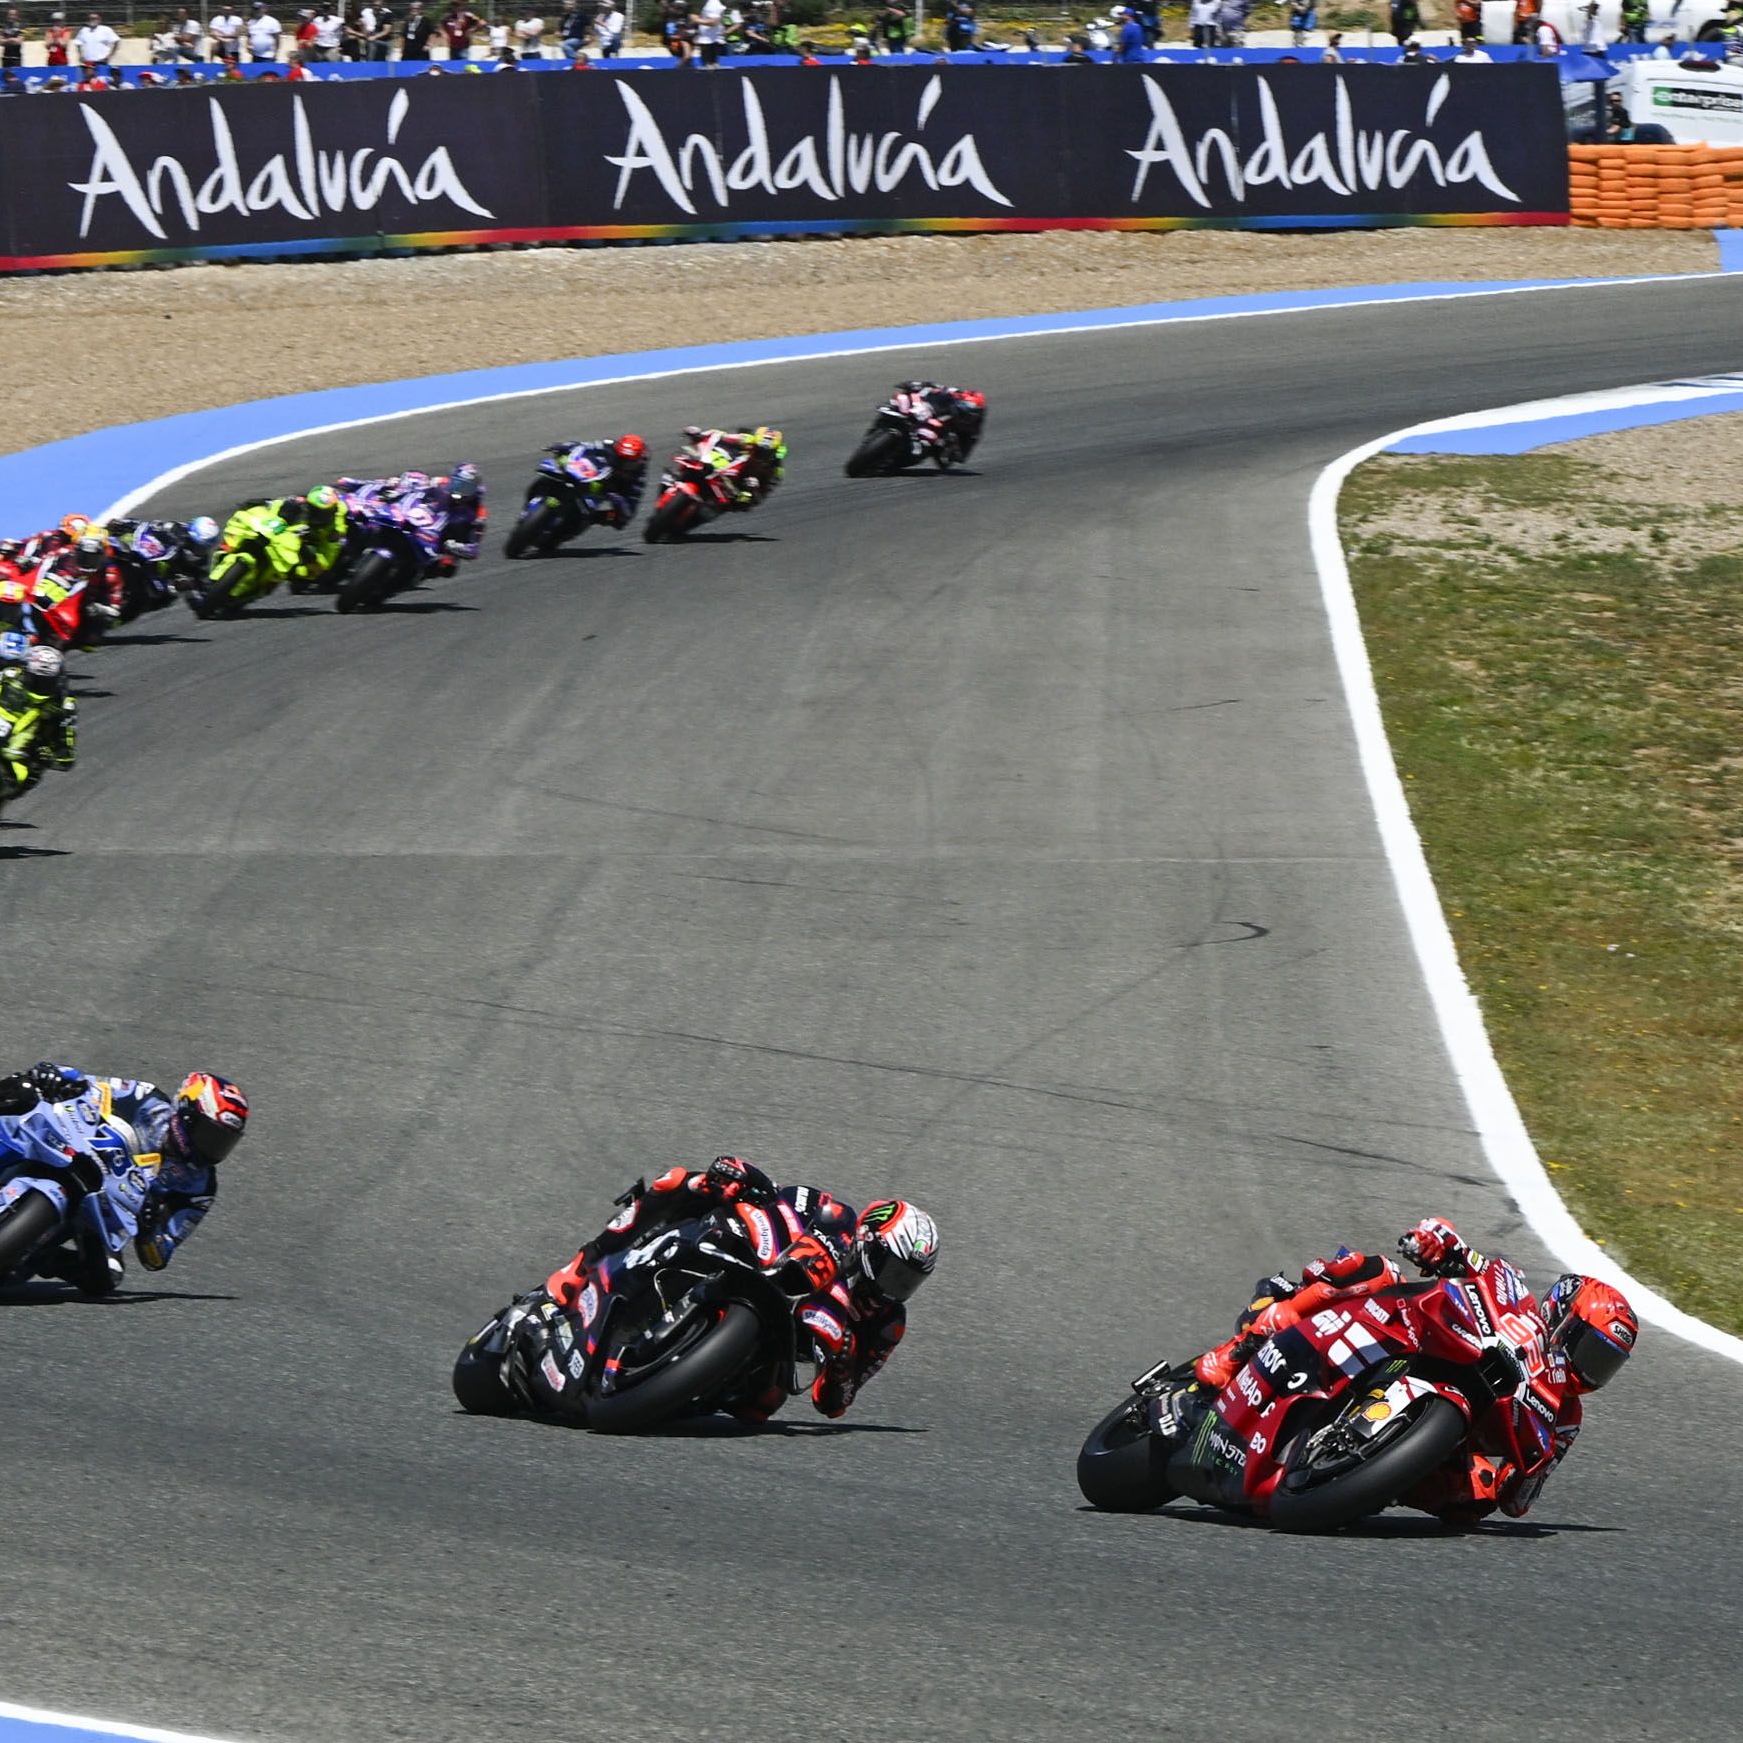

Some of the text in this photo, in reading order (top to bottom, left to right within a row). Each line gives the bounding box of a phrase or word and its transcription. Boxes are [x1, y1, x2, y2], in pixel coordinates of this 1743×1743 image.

[68, 88, 496, 240] Andalucía
[603, 74, 1016, 215] Andalucía
[1125, 72, 1523, 208] Andalucía
[1464, 1283, 1492, 1335] Lenovo
[1526, 1388, 1554, 1423] Lenovo
